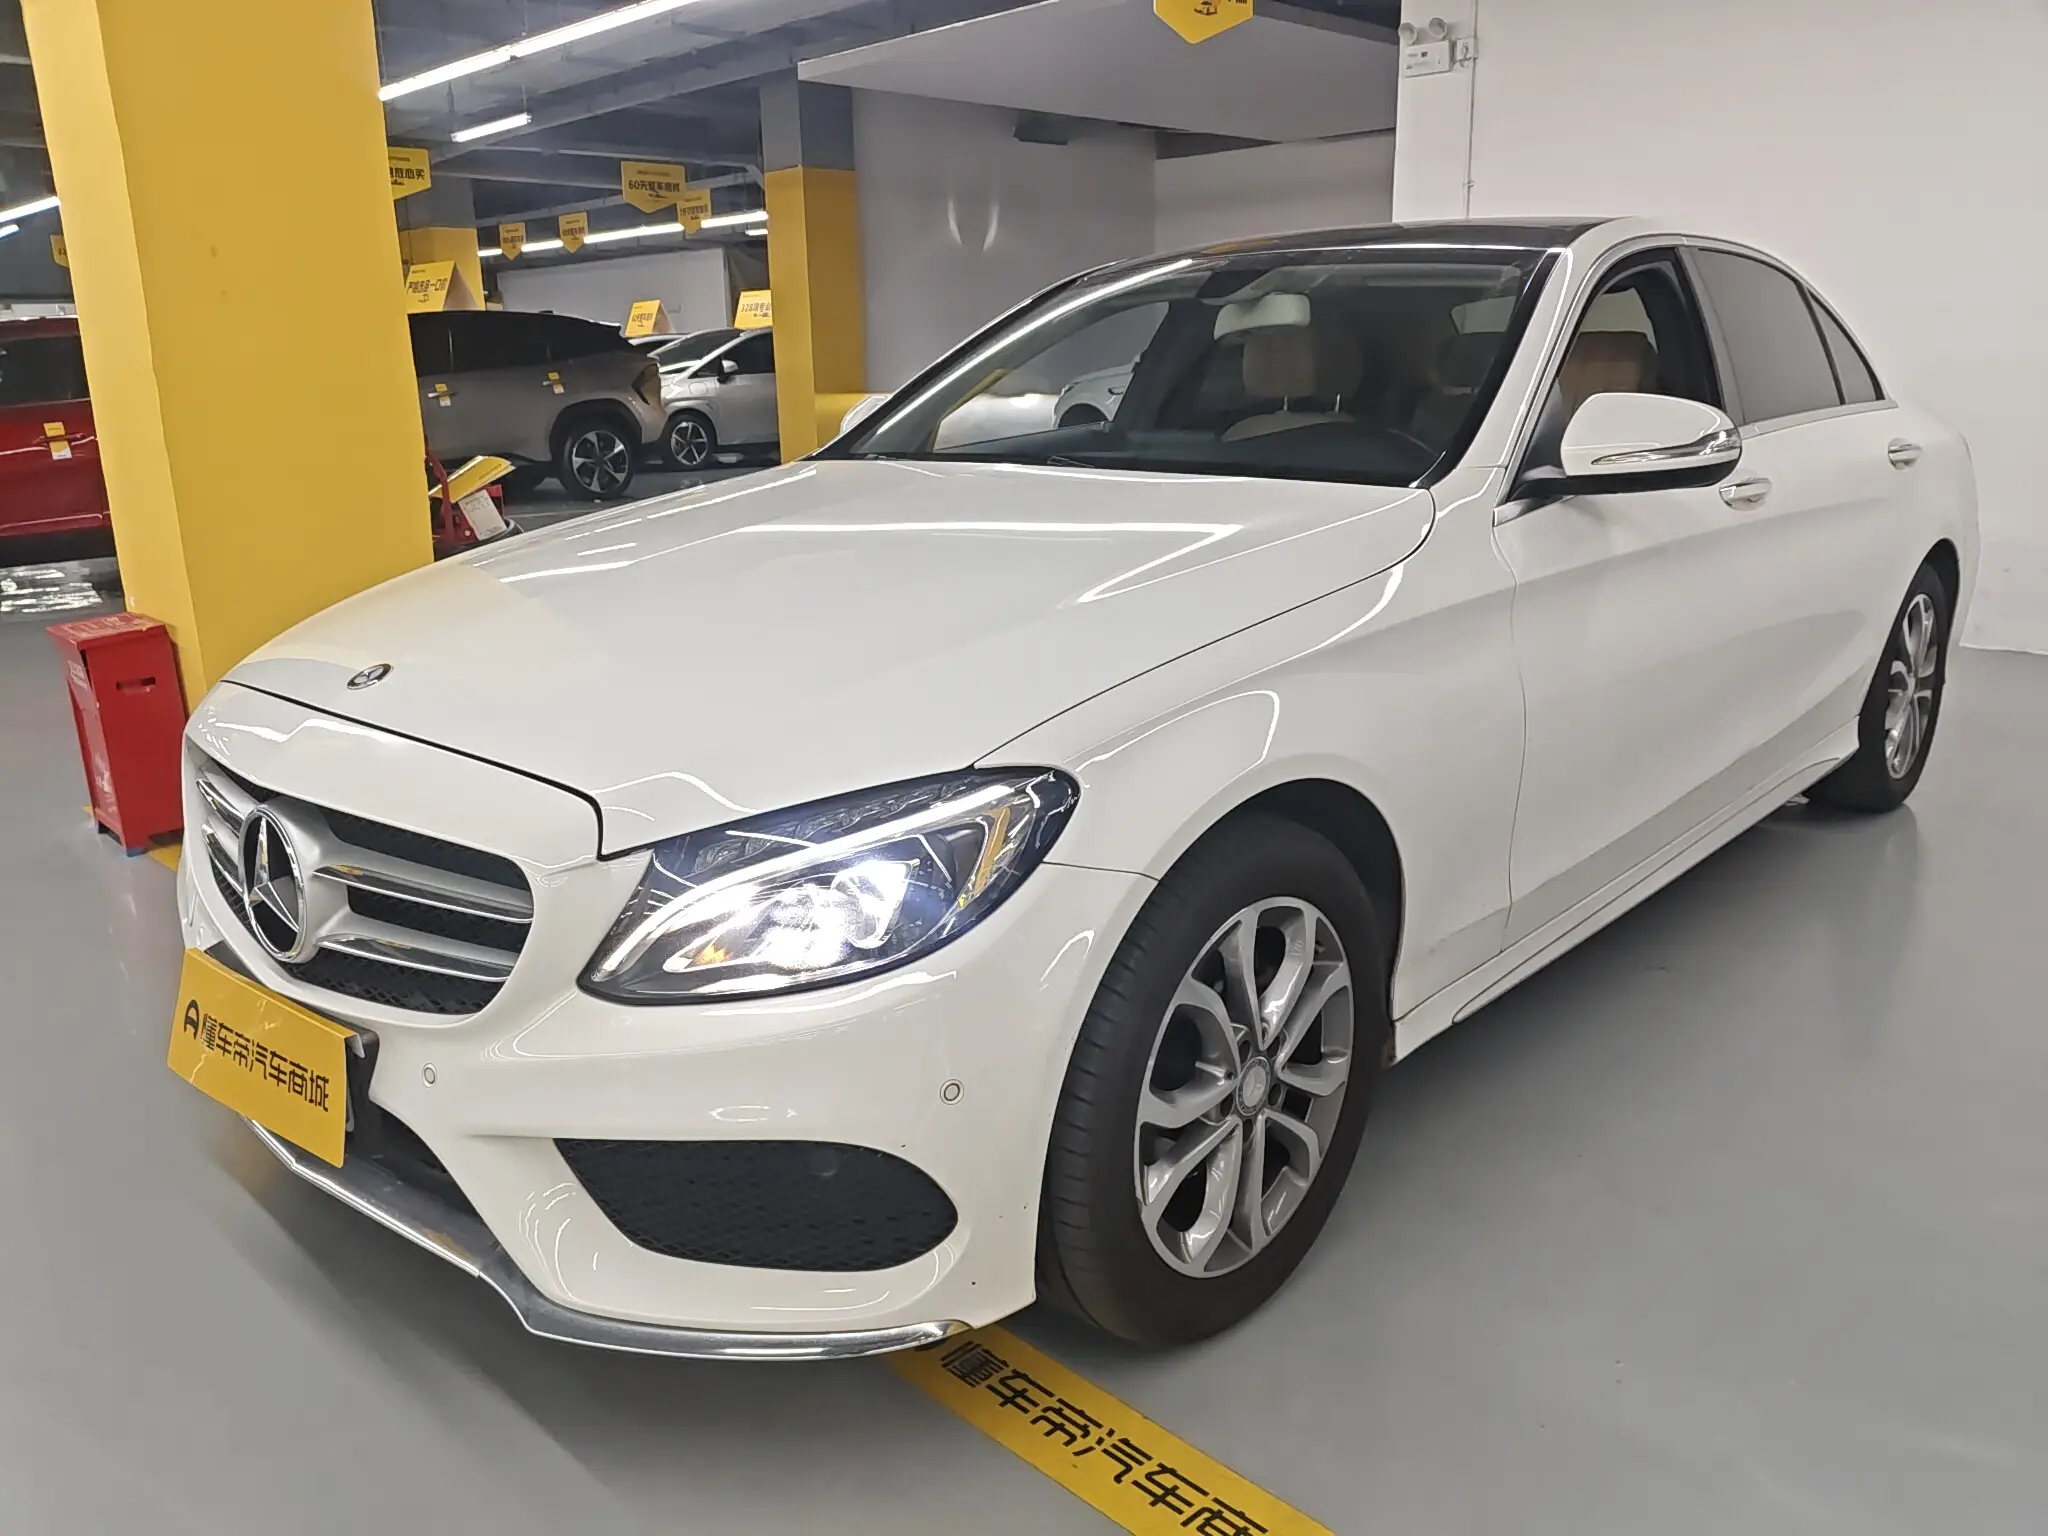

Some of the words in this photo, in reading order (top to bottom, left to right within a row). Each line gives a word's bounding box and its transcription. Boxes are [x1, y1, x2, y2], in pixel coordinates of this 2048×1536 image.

[200, 1012, 330, 1113] 懂车帝汽车商城
